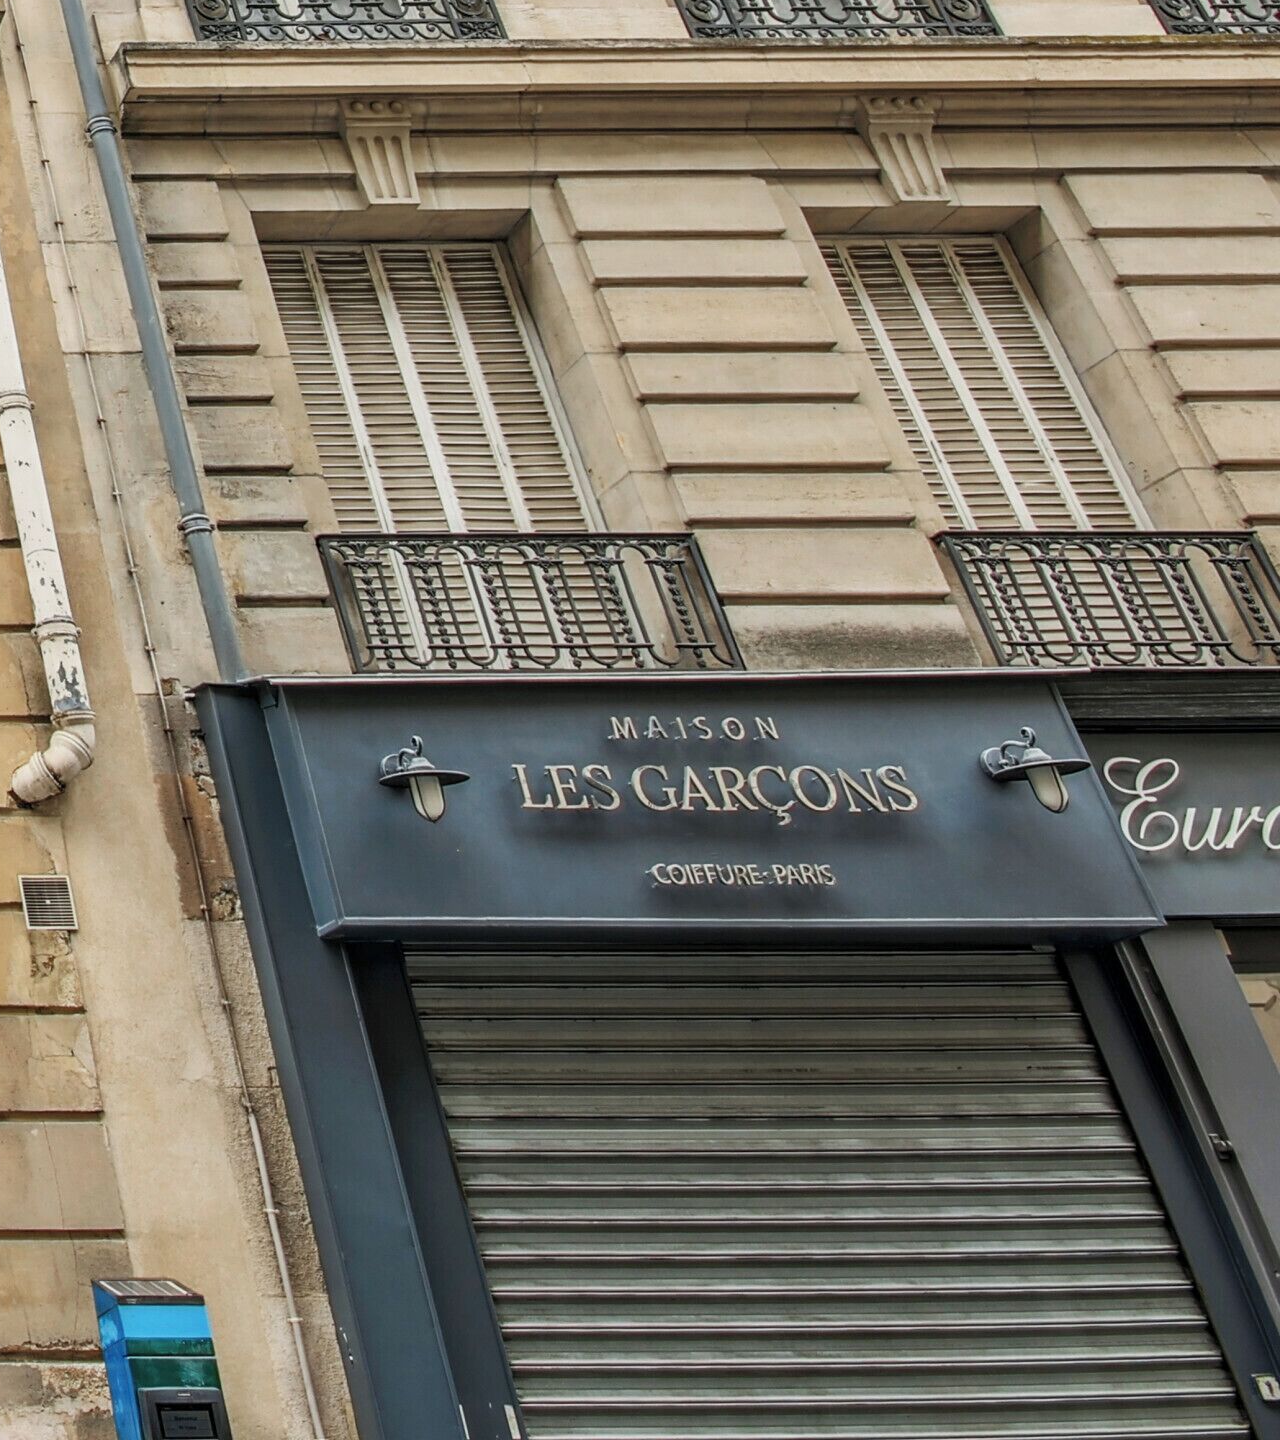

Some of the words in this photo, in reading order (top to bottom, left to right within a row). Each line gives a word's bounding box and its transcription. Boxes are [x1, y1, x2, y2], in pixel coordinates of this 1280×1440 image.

[608, 715, 780, 741] MAISON
[511, 763, 622, 812] LES
[630, 764, 919, 826] GARÇONS
